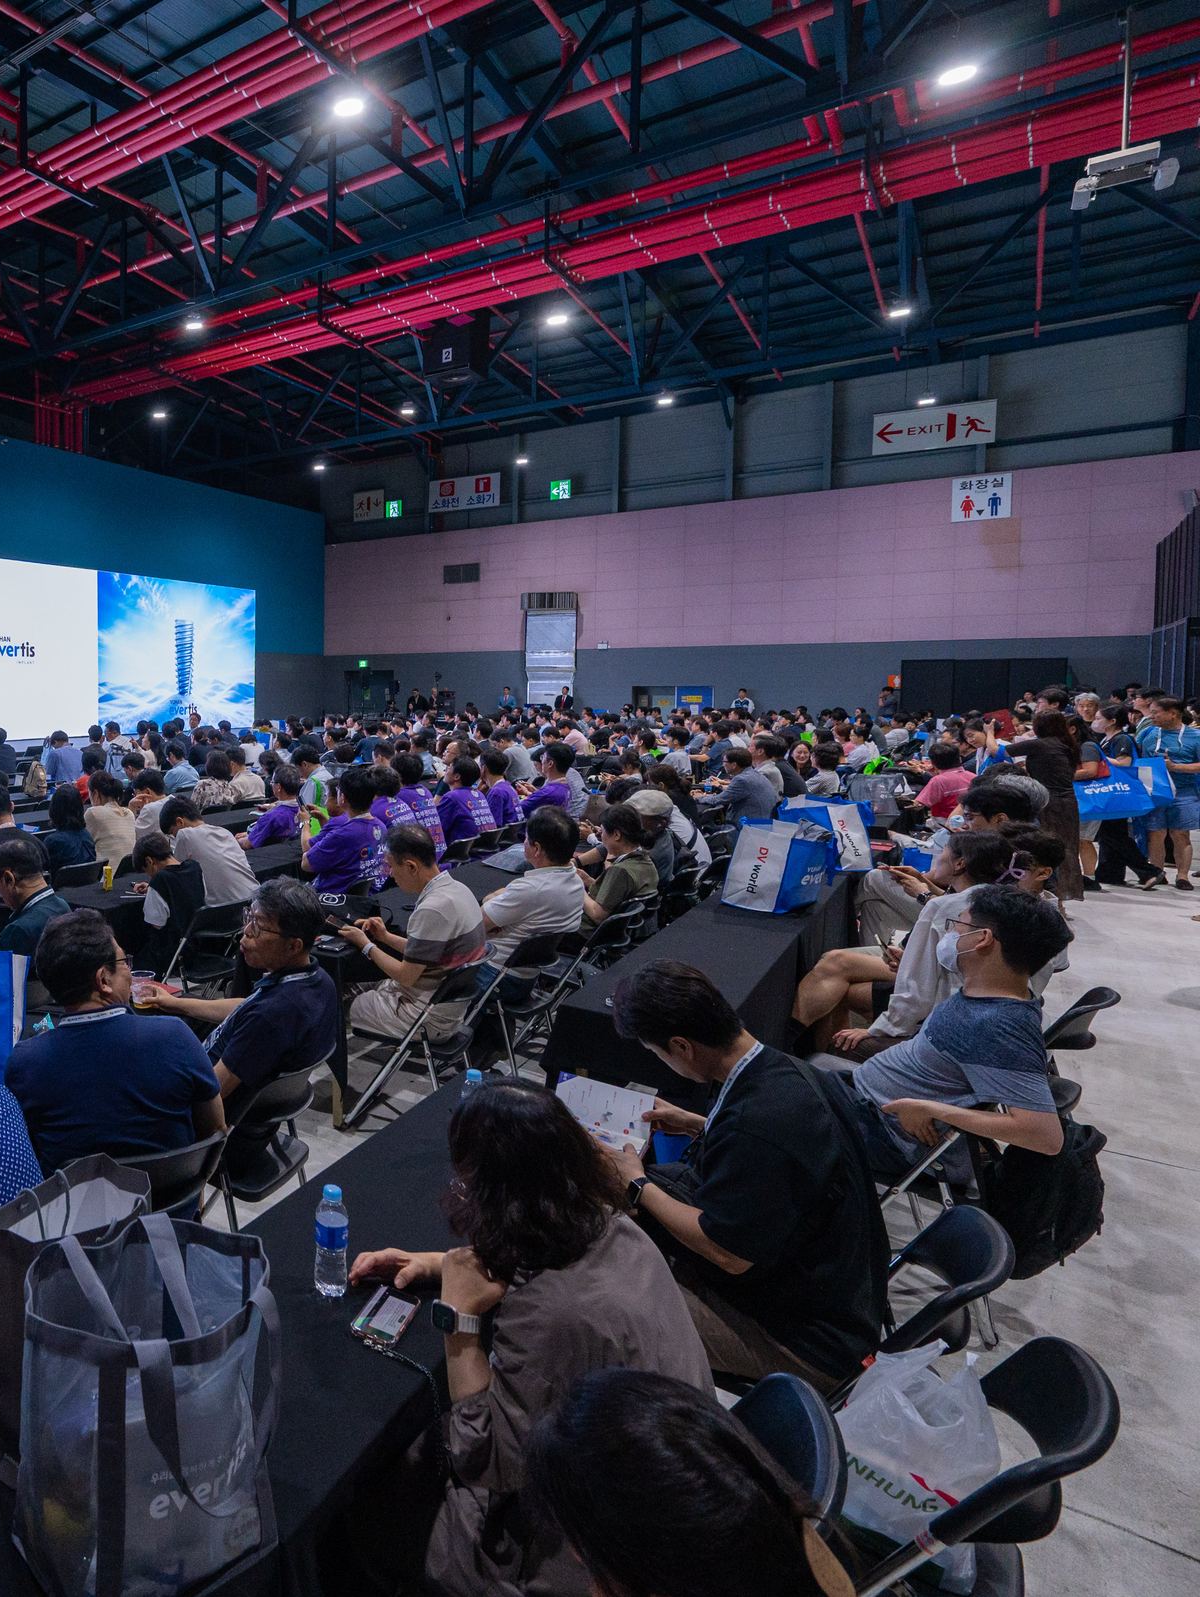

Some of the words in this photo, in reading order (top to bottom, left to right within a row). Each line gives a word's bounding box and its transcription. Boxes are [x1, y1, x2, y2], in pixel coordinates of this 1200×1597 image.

[443, 350, 452, 361] 2
[907, 423, 945, 436] EXIT
[959, 476, 1004, 491] 화장실
[431, 496, 460, 510] 소화전
[466, 492, 495, 506] 소화기
[169, 702, 198, 716] evertis
[1084, 782, 1130, 795] evertis
[756, 846, 769, 864] DV
[746, 864, 762, 894] world
[846, 1452, 938, 1513] NHUNG
